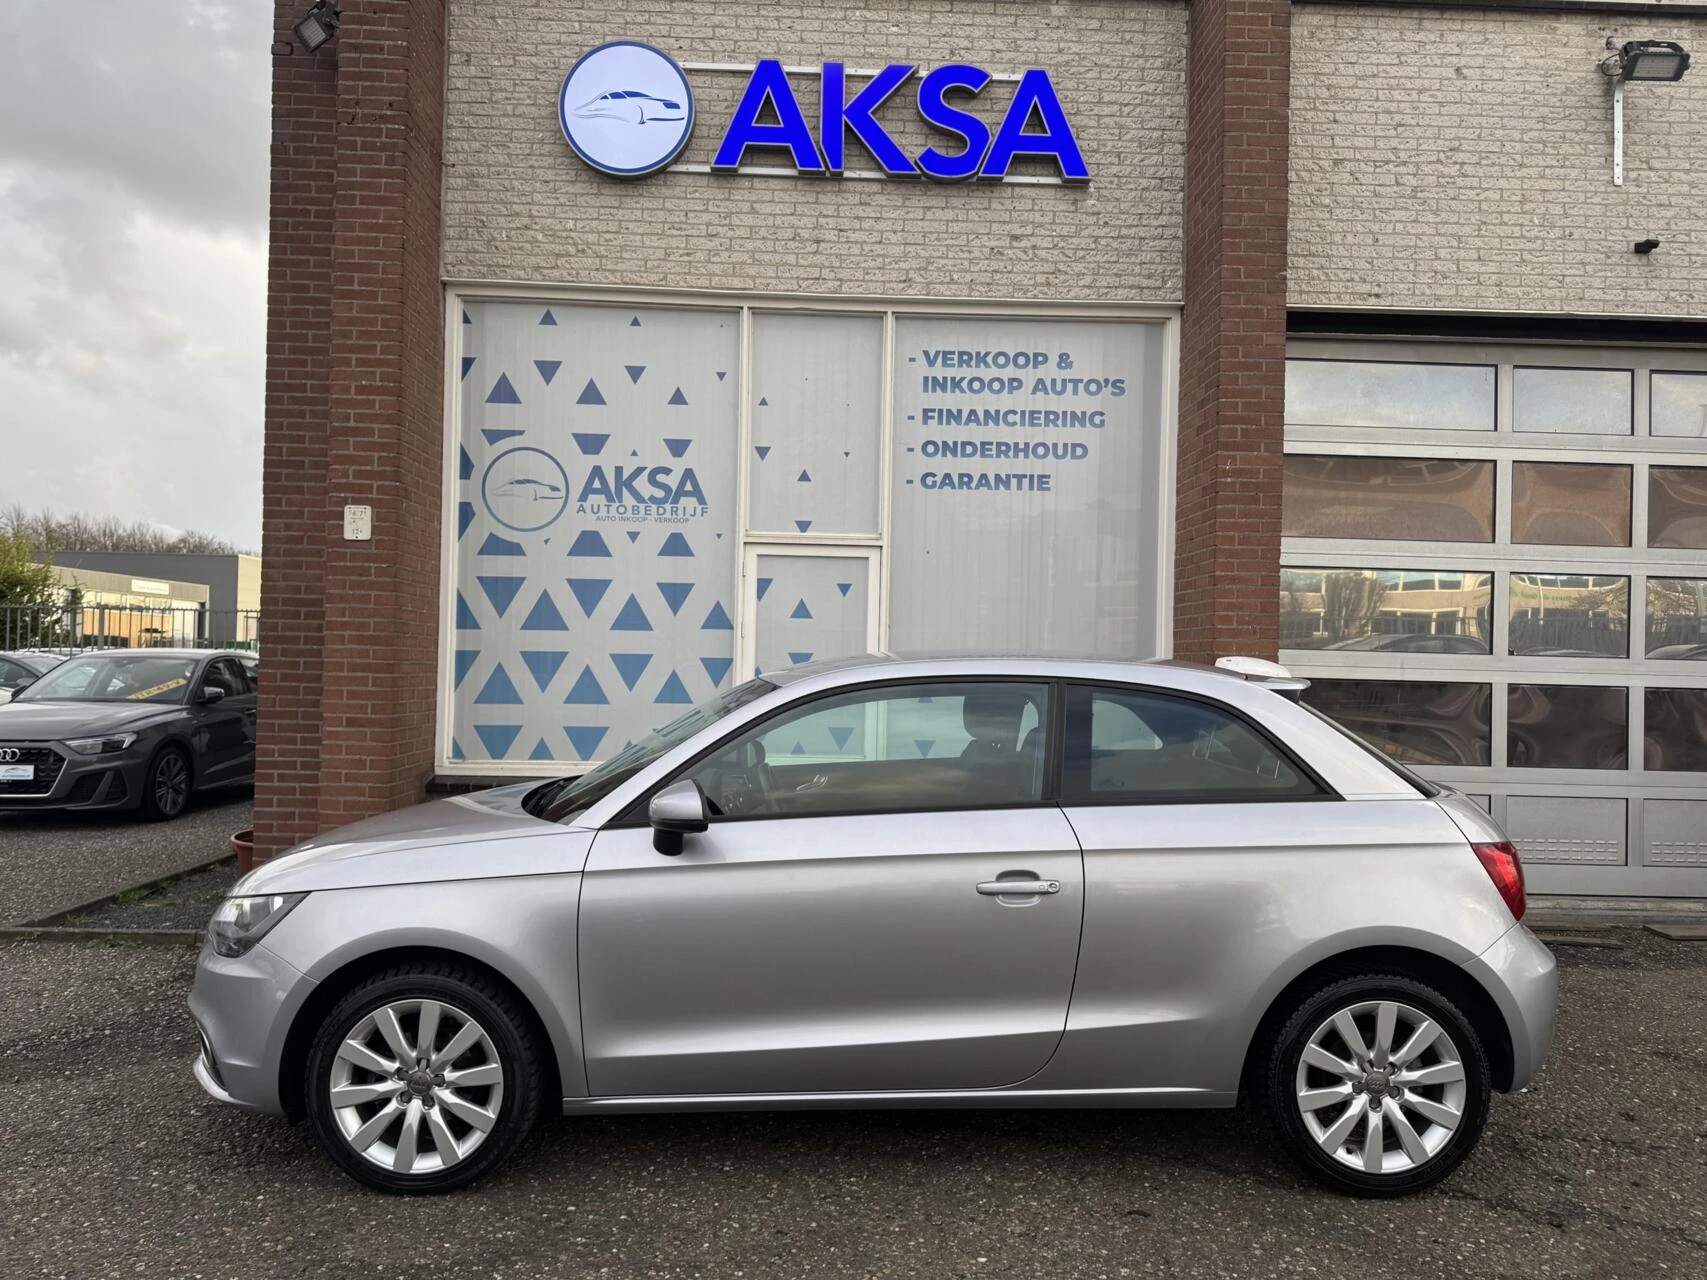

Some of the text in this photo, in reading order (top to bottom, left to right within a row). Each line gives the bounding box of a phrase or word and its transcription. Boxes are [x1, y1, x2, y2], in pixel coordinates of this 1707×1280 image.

[711, 59, 1091, 184] AKSA
[922, 350, 1048, 369] VERKOOP
[1056, 352, 1074, 370] &
[922, 376, 1126, 397] INKOOP AUTO'S
[921, 408, 1106, 428] FINANCIERING
[920, 440, 1089, 460] ONDERHOUD
[577, 465, 708, 505] AKSA
[920, 472, 1051, 491] GARANTIE
[576, 504, 709, 517] AUTOBEDRIJF
